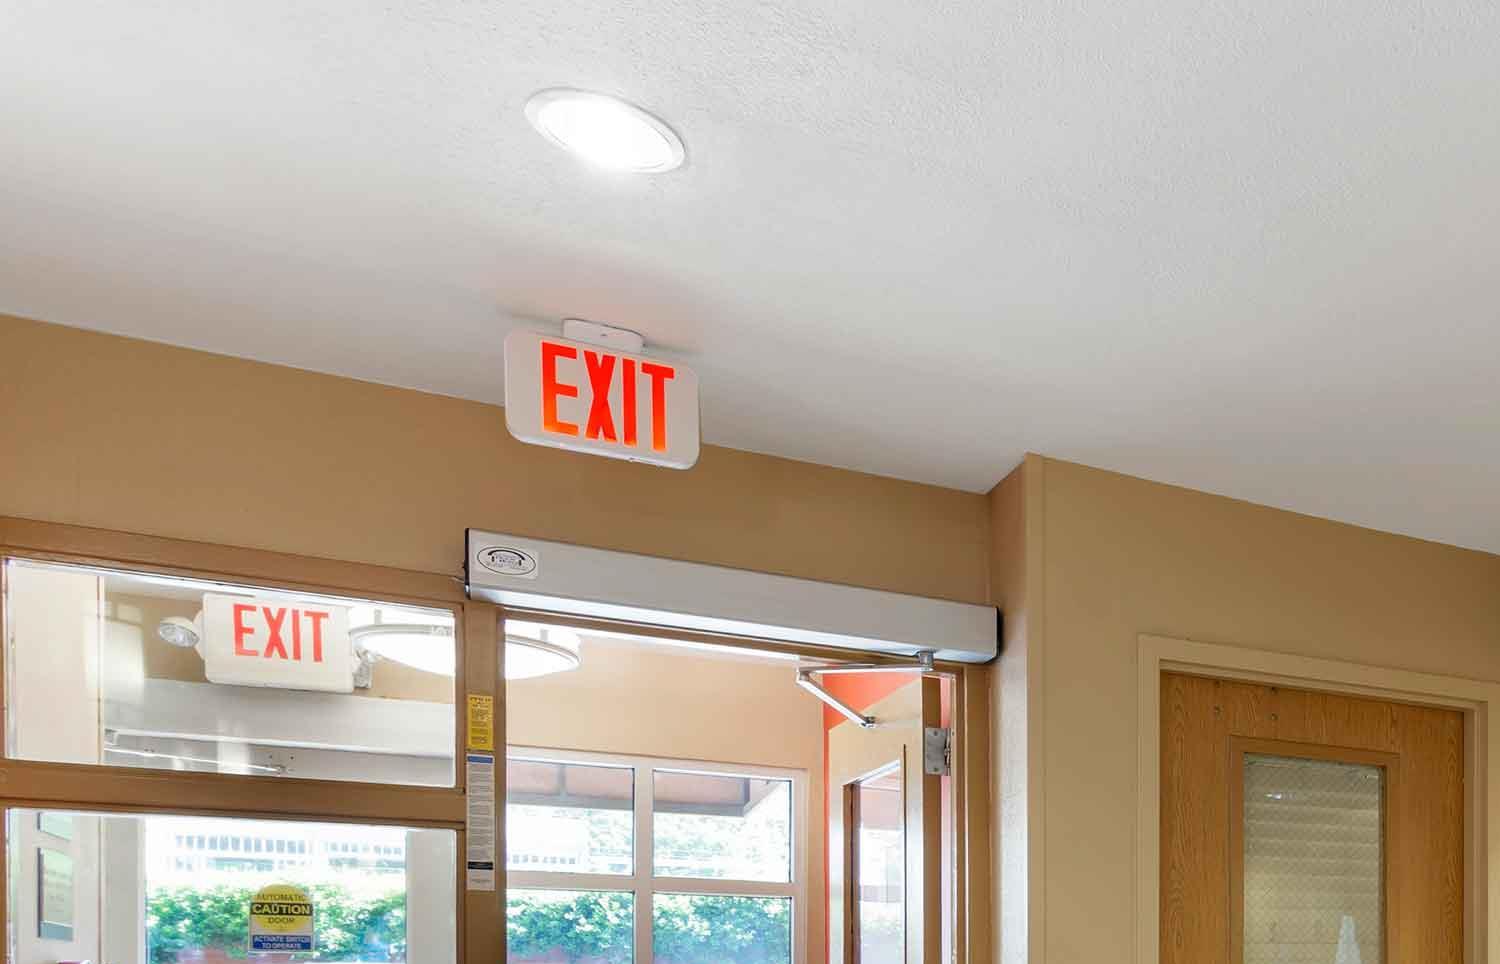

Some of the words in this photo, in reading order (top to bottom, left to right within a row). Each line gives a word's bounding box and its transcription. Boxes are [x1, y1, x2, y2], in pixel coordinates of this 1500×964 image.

[541, 340, 675, 453] EXIT
[233, 604, 329, 662] EXIT
[252, 904, 310, 914] CAUTION
